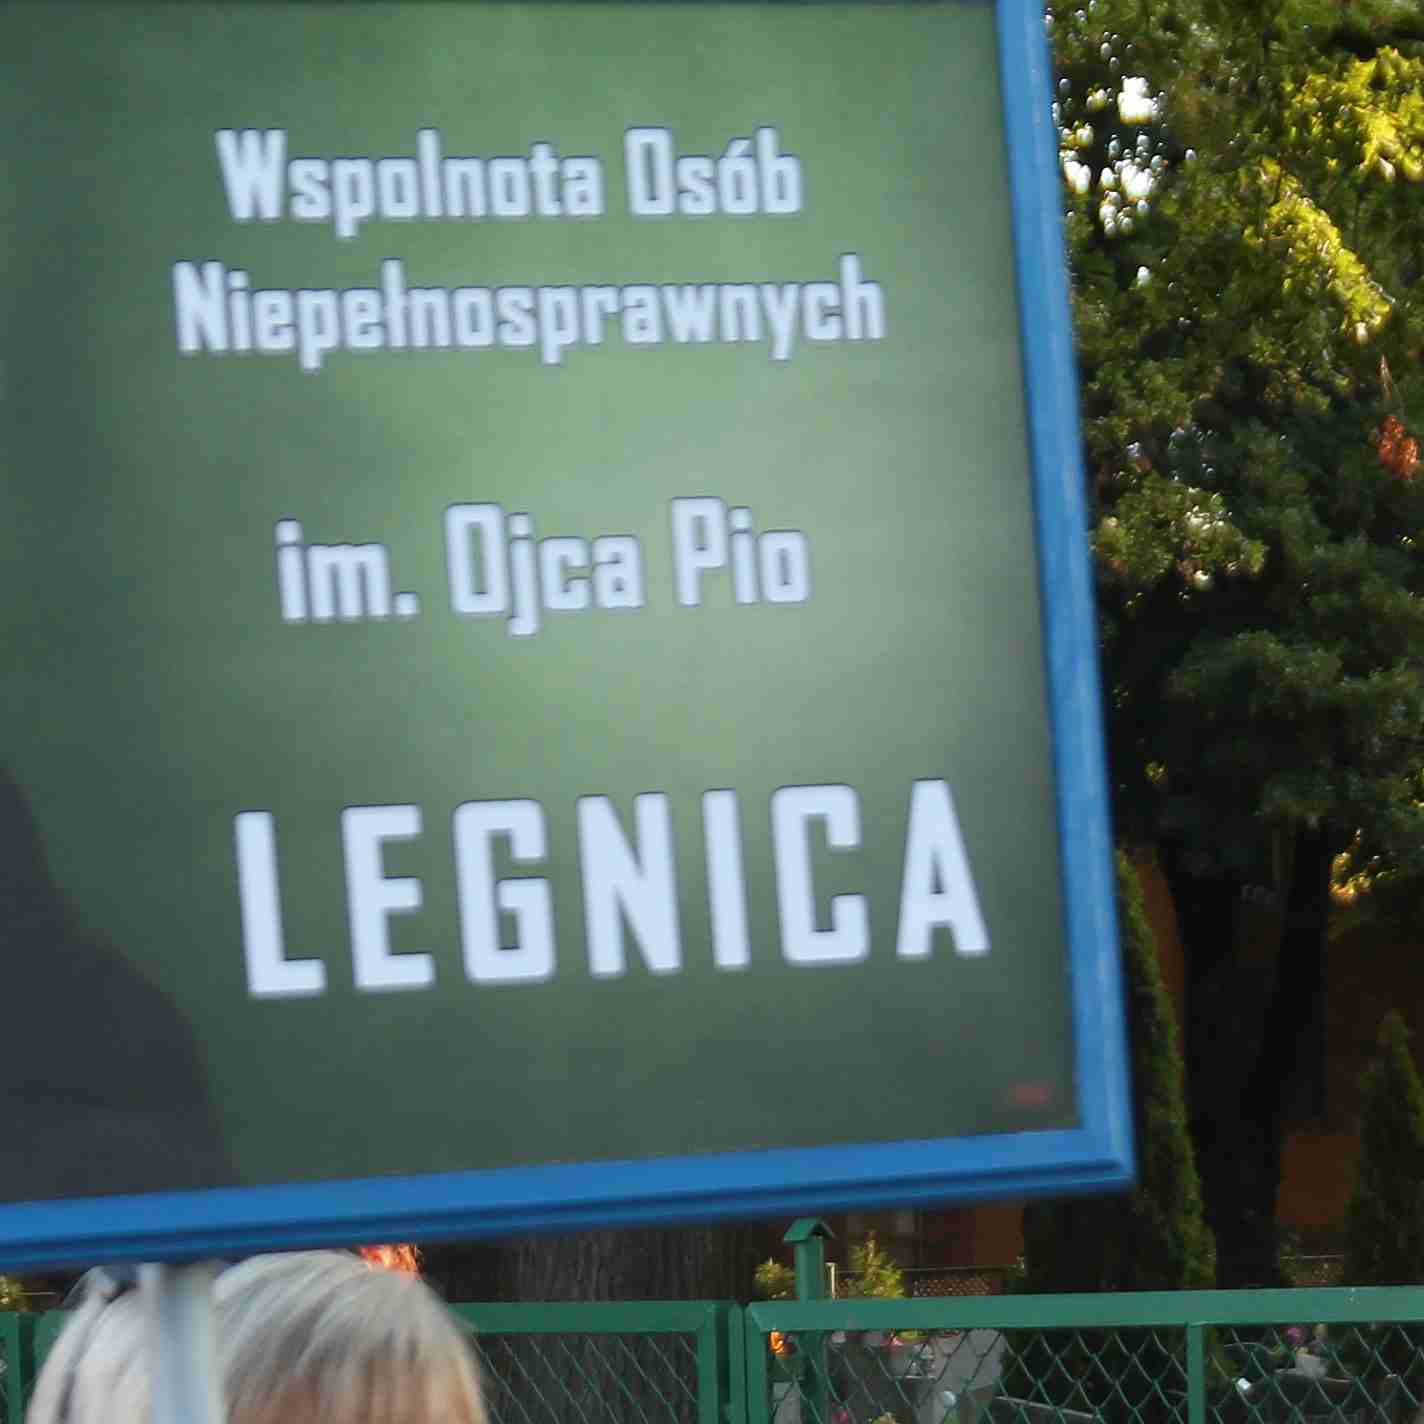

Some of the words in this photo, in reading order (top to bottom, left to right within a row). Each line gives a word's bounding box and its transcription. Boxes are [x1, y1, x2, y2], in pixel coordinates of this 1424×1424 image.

[219, 129, 602, 238] Wspolnota
[625, 128, 801, 216] Osób
[176, 254, 884, 370] Niepełnosprawnych
[278, 521, 418, 620] im.
[446, 504, 645, 637] Ojca
[670, 497, 810, 607] Pio
[238, 779, 987, 994] LEGNICA
